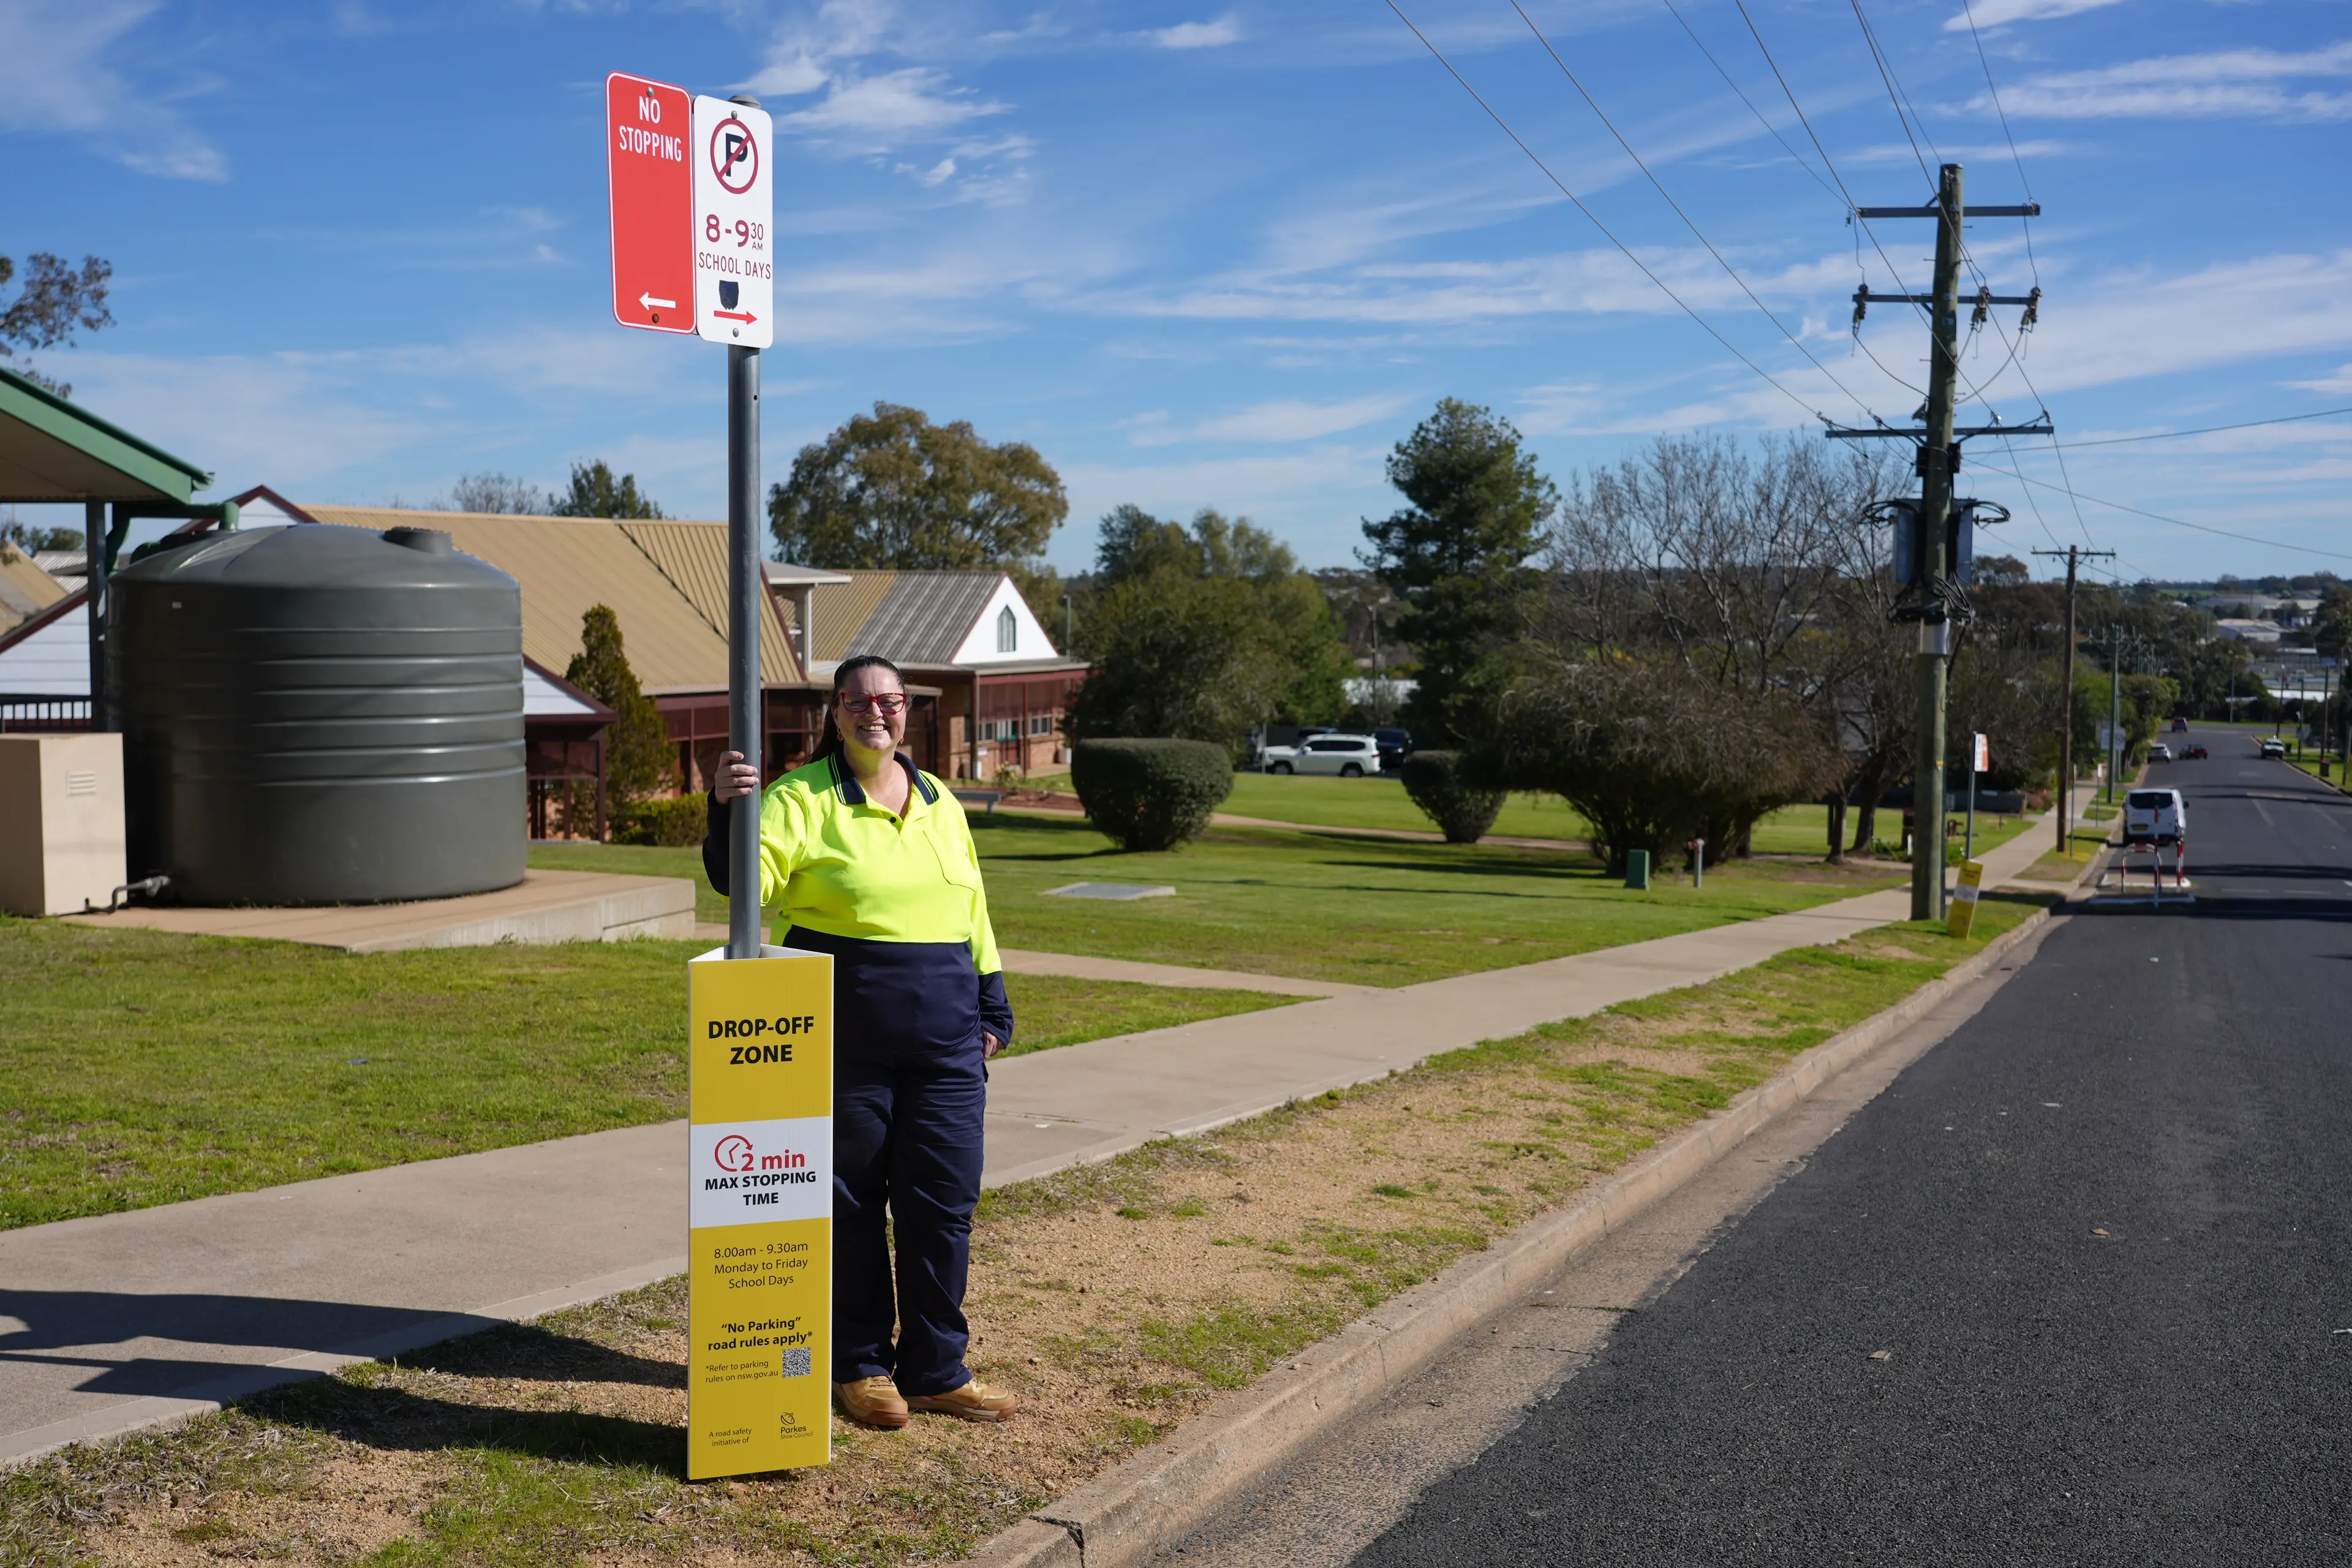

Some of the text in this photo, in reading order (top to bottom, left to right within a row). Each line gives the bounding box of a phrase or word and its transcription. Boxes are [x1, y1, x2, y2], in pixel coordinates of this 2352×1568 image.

[639, 96, 660, 123] NO
[619, 126, 681, 162] STOPPING
[752, 241, 763, 251] AM
[699, 252, 771, 279] SCHOOL DAYS
[709, 1016, 814, 1039] DROP-OFF
[729, 1044, 793, 1065] ZONE
[741, 1150, 805, 1172] 2 min
[705, 1170, 816, 1191] MAX STOPPING
[743, 1192, 778, 1206] TIME
[714, 1247, 756, 1258] 8.00am
[767, 1243, 808, 1254] 9.30am
[714, 1262, 759, 1274] Monday
[776, 1258, 808, 1269] Friday
[729, 1276, 794, 1289] School Days
[708, 1338, 736, 1351] road
[740, 1336, 770, 1348] rules
[740, 1361, 769, 1370] parking
[706, 1373, 723, 1382] rules
[737, 1370, 778, 1379] nsw.gov.au
[733, 1428, 752, 1436] safety
[780, 1425, 807, 1434] Parkes
[712, 1438, 741, 1447] initiative
